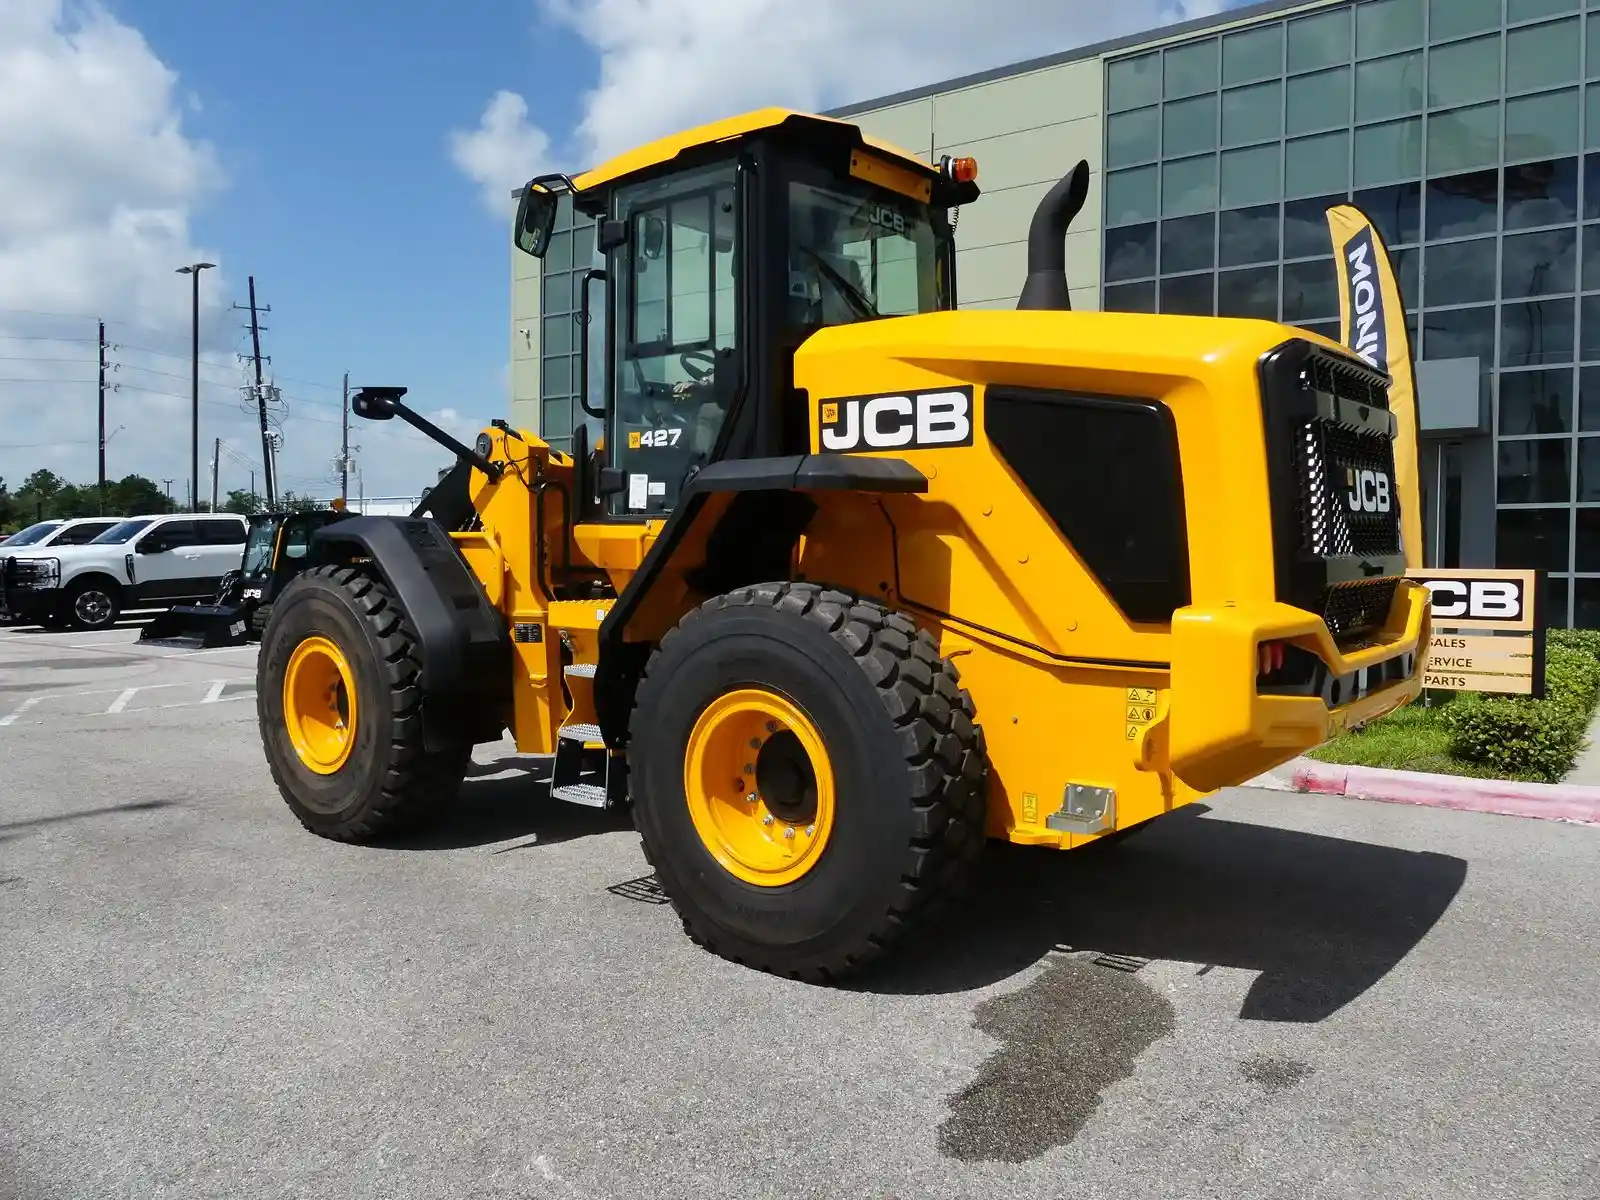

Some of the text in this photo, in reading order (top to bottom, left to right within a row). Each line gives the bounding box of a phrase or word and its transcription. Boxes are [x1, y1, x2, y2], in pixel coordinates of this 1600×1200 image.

[870, 207, 904, 232] JCB
[822, 392, 969, 450] JCB
[640, 428, 682, 447] 427
[1348, 469, 1390, 512] JCB
[243, 588, 262, 599] JCB
[1422, 580, 1520, 617] CB
[1424, 675, 1467, 687] PARTS
